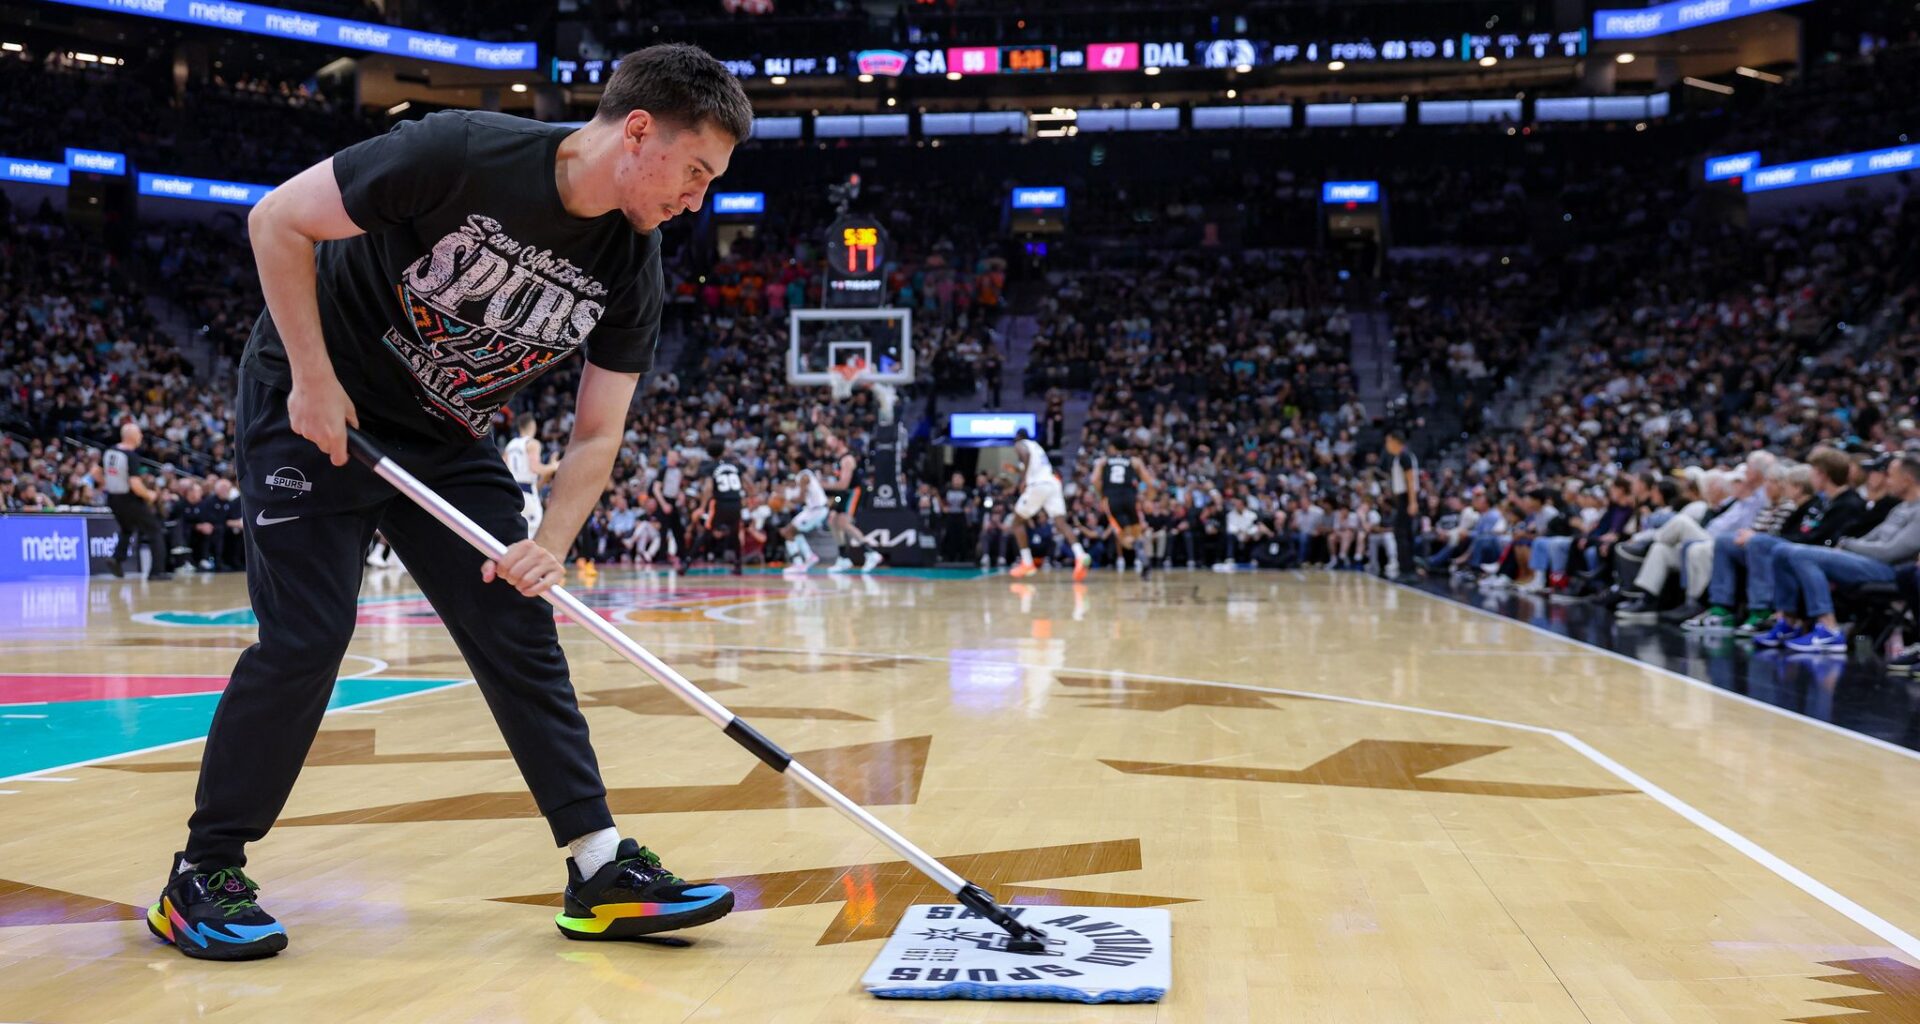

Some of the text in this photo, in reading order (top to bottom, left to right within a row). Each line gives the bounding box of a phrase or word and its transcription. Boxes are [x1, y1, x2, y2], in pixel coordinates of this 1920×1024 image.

[1606, 13, 1662, 33] meter
[189, 2, 246, 25] meter
[265, 13, 320, 37] meter
[339, 25, 390, 47] meter
[408, 36, 459, 58] meter
[475, 46, 525, 65] meter
[914, 50, 947, 73] SA
[1143, 43, 1189, 68] DAL
[74, 152, 117, 170] meter
[1713, 156, 1752, 174] meter
[1755, 150, 1914, 186] meter meter meter
[9, 162, 54, 180] meter
[152, 178, 194, 196] meter
[209, 184, 250, 201] meter
[1020, 190, 1057, 204] meter
[1331, 184, 1370, 199] meter
[720, 195, 757, 210] meter
[518, 245, 609, 297] Antonio
[402, 231, 606, 346] SPURS
[273, 477, 305, 490] SPURS
[1109, 465, 1126, 484] 2
[21, 531, 80, 562] meter
[1041, 914, 1154, 967] ANTONIO
[887, 965, 1085, 982] SPURS
